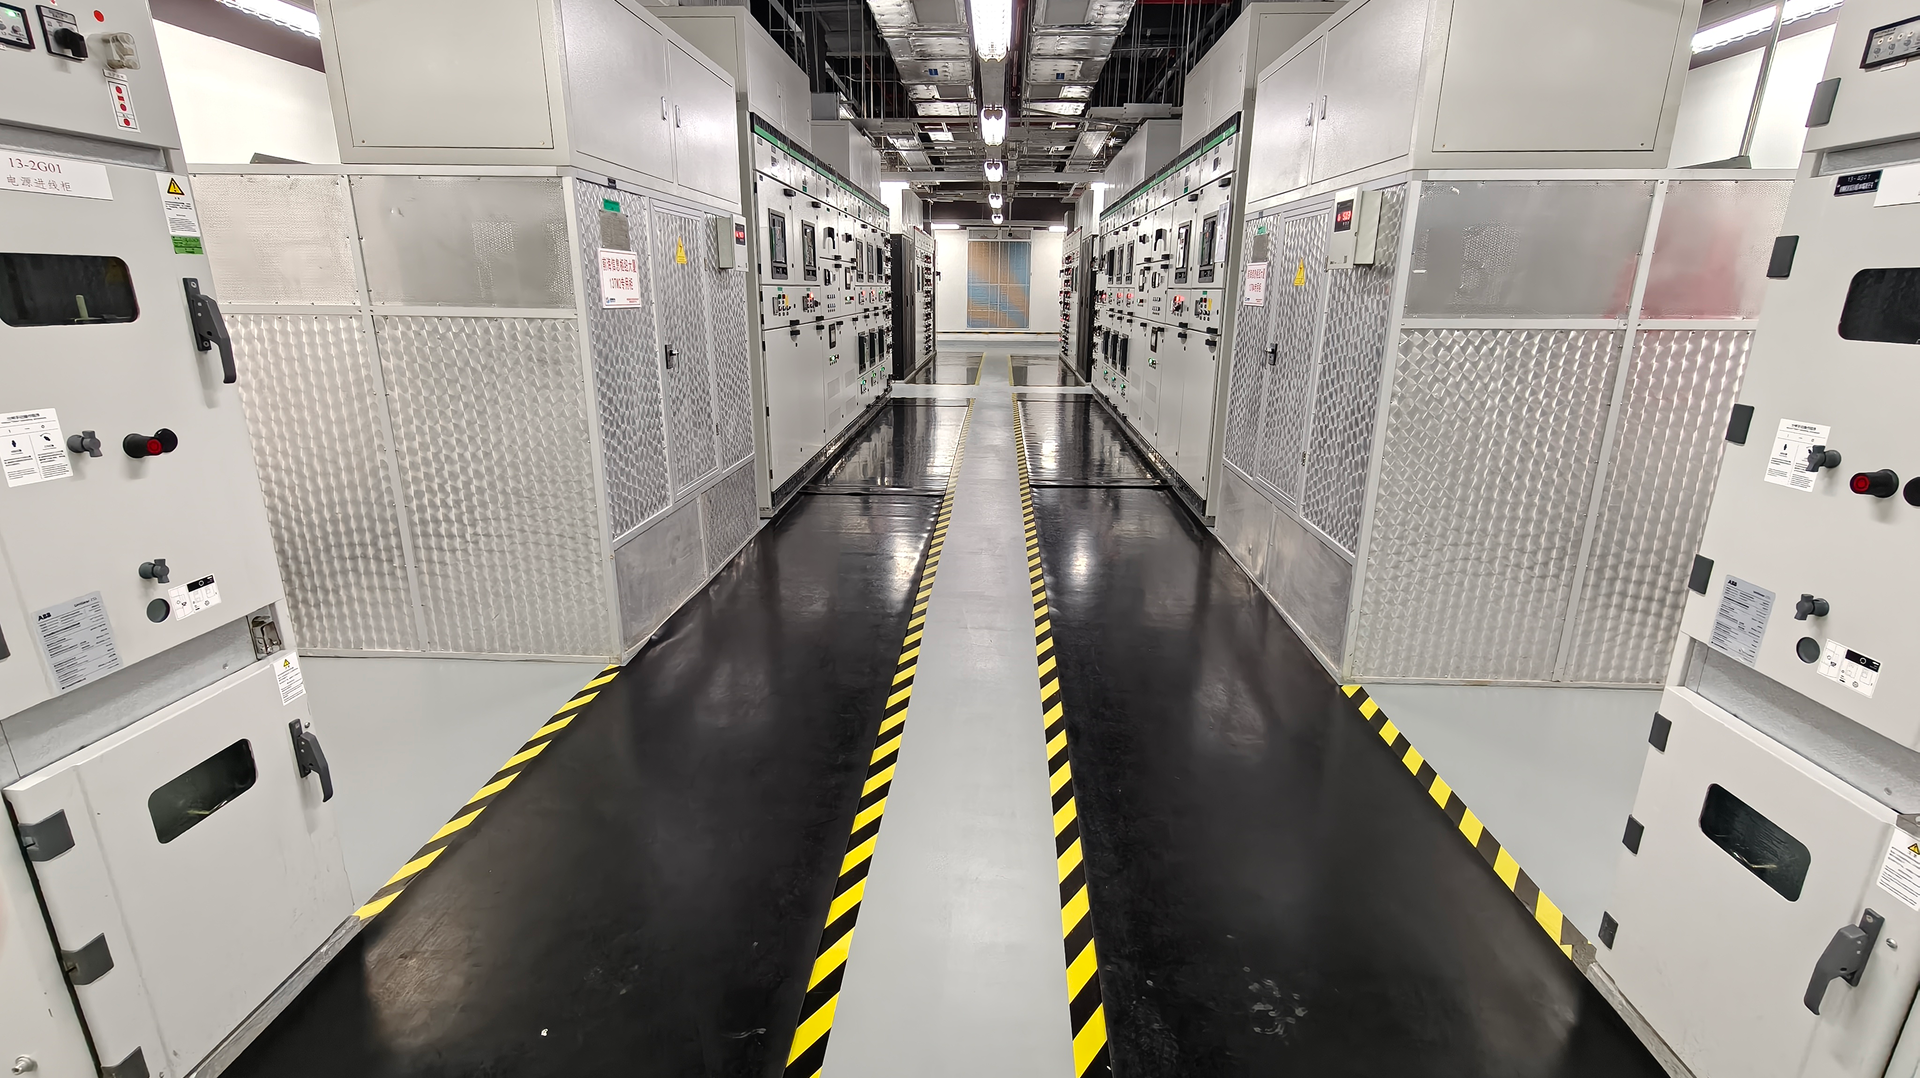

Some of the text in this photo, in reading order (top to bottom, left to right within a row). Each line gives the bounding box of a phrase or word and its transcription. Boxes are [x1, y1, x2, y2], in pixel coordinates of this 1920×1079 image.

[8, 157, 62, 174] 13-2G01
[6, 174, 72, 192] 电源进线柜
[38, 612, 51, 621] ABB
